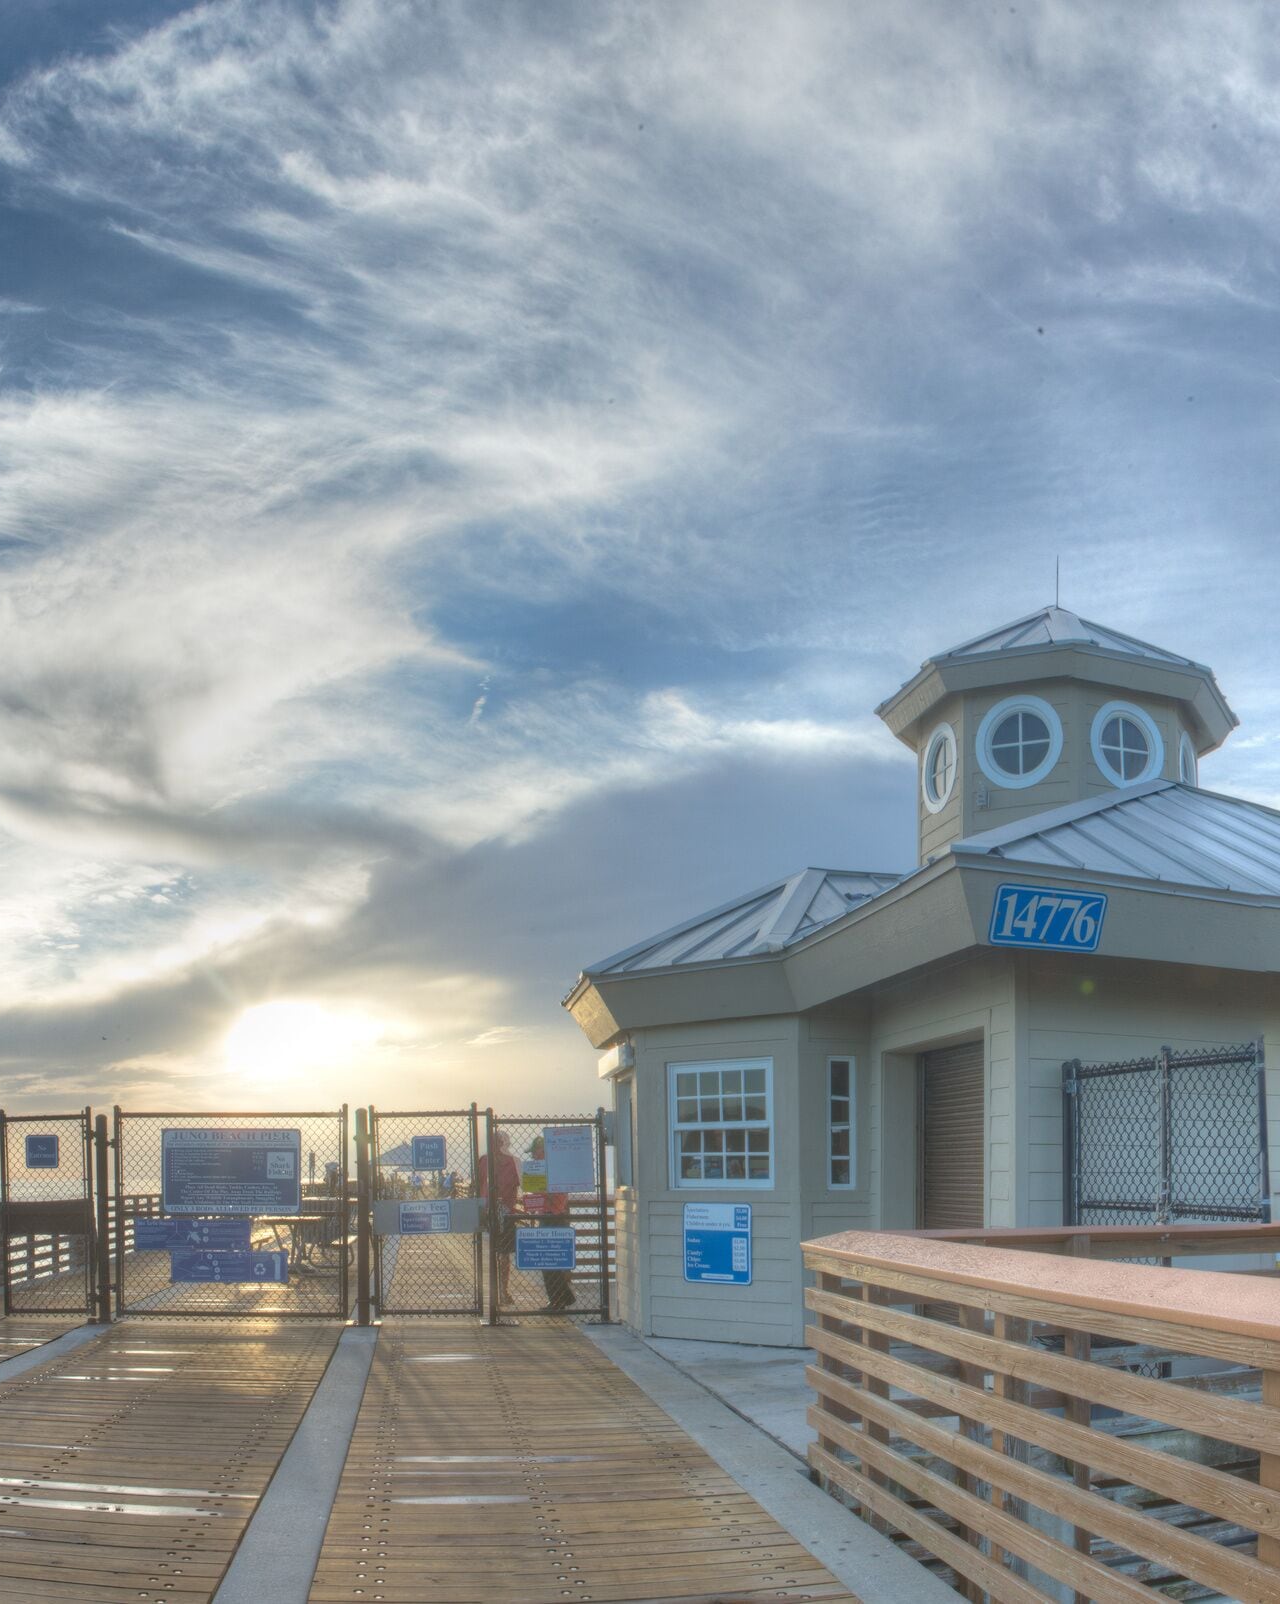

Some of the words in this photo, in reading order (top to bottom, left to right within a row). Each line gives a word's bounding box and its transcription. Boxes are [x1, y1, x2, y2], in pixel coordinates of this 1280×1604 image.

[997, 893, 1101, 943] 14776
[172, 1131, 207, 1141] JUNO
[211, 1131, 257, 1141] BEACH
[260, 1131, 291, 1141] PIER
[420, 1142, 439, 1150] Push
[419, 1156, 441, 1164] Enter
[268, 1169, 294, 1178] Fishing
[403, 1204, 427, 1213] Entry
[519, 1230, 535, 1238] Juno
[536, 1230, 549, 1238] Pier
